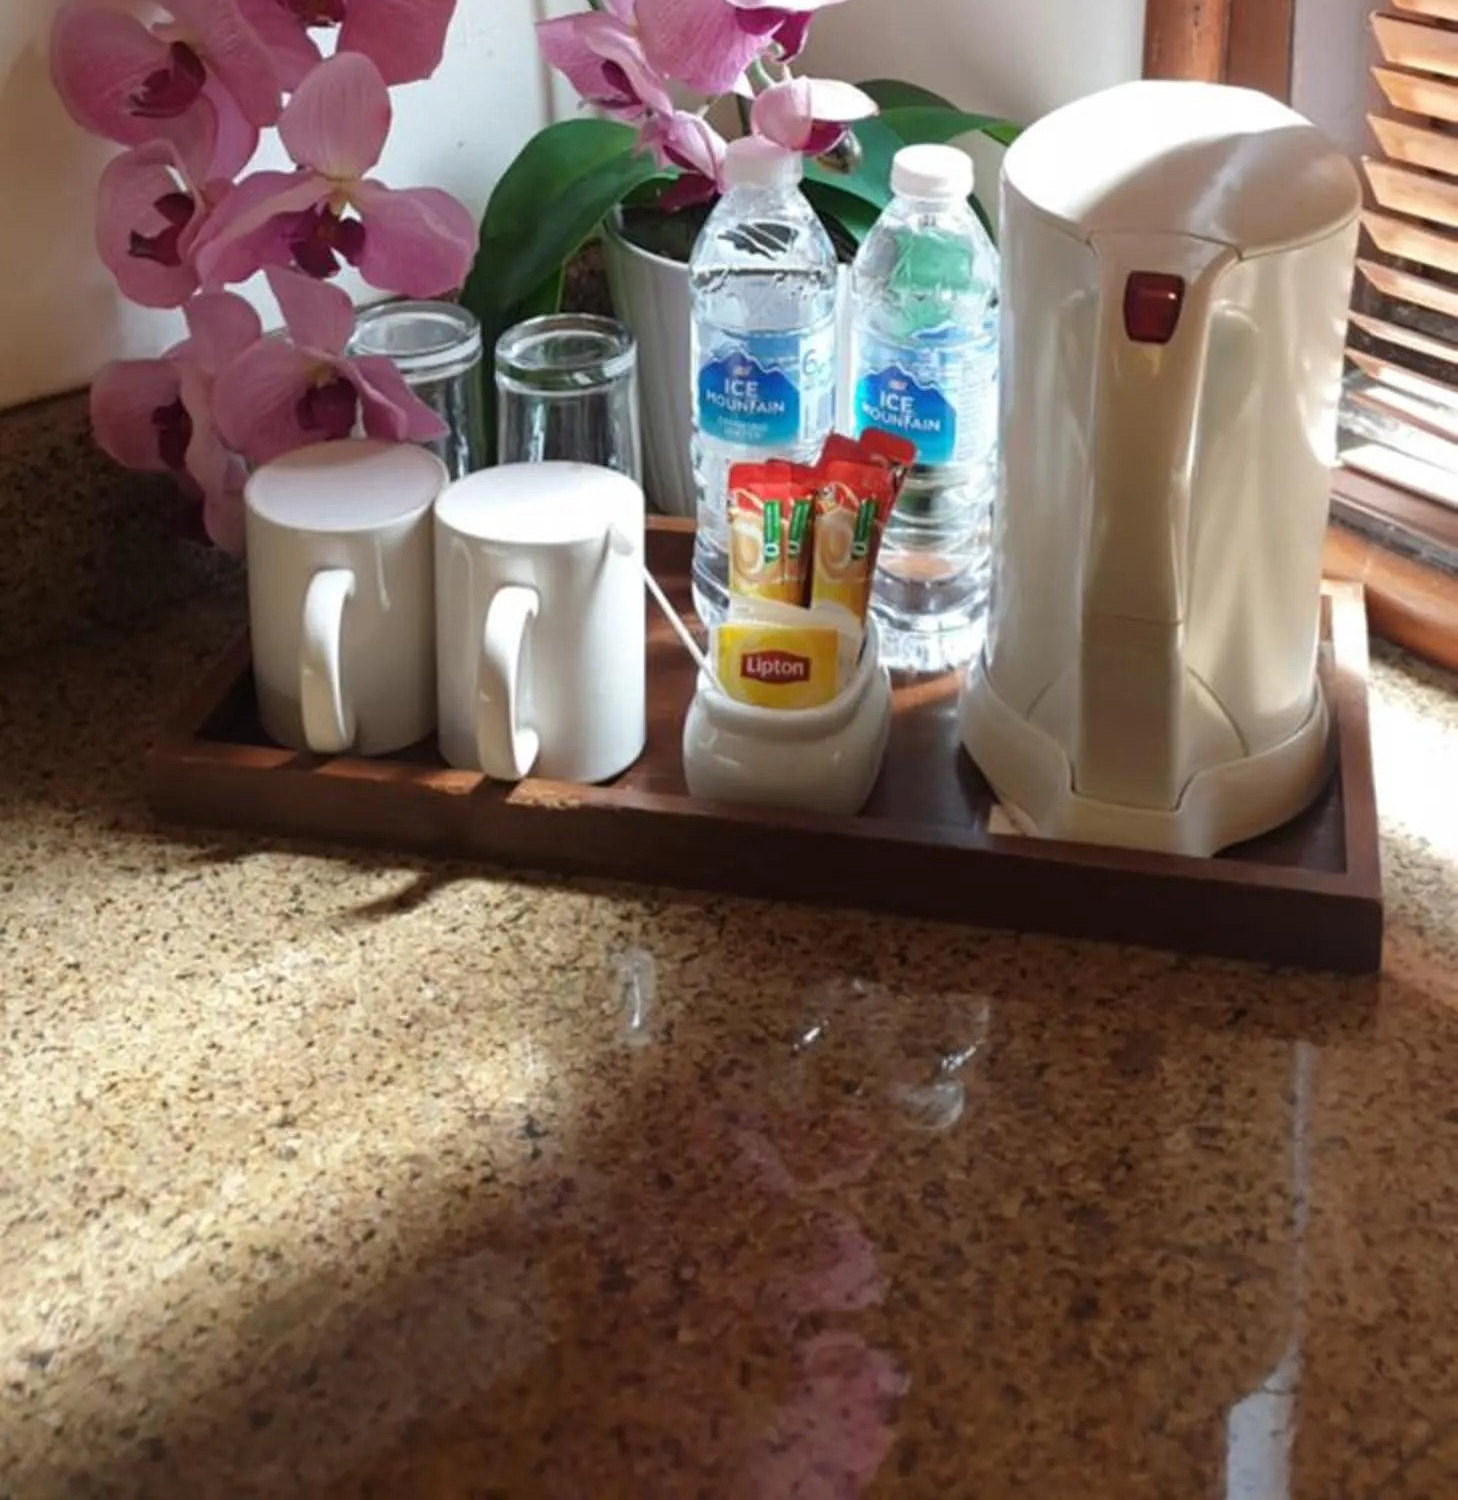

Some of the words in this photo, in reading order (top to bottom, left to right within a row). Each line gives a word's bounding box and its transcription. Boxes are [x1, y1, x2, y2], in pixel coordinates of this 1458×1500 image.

[724, 378, 759, 398] ICE
[705, 388, 785, 415] MOUNTAIN
[880, 391, 914, 415] ICE
[746, 655, 804, 678] Lipton
